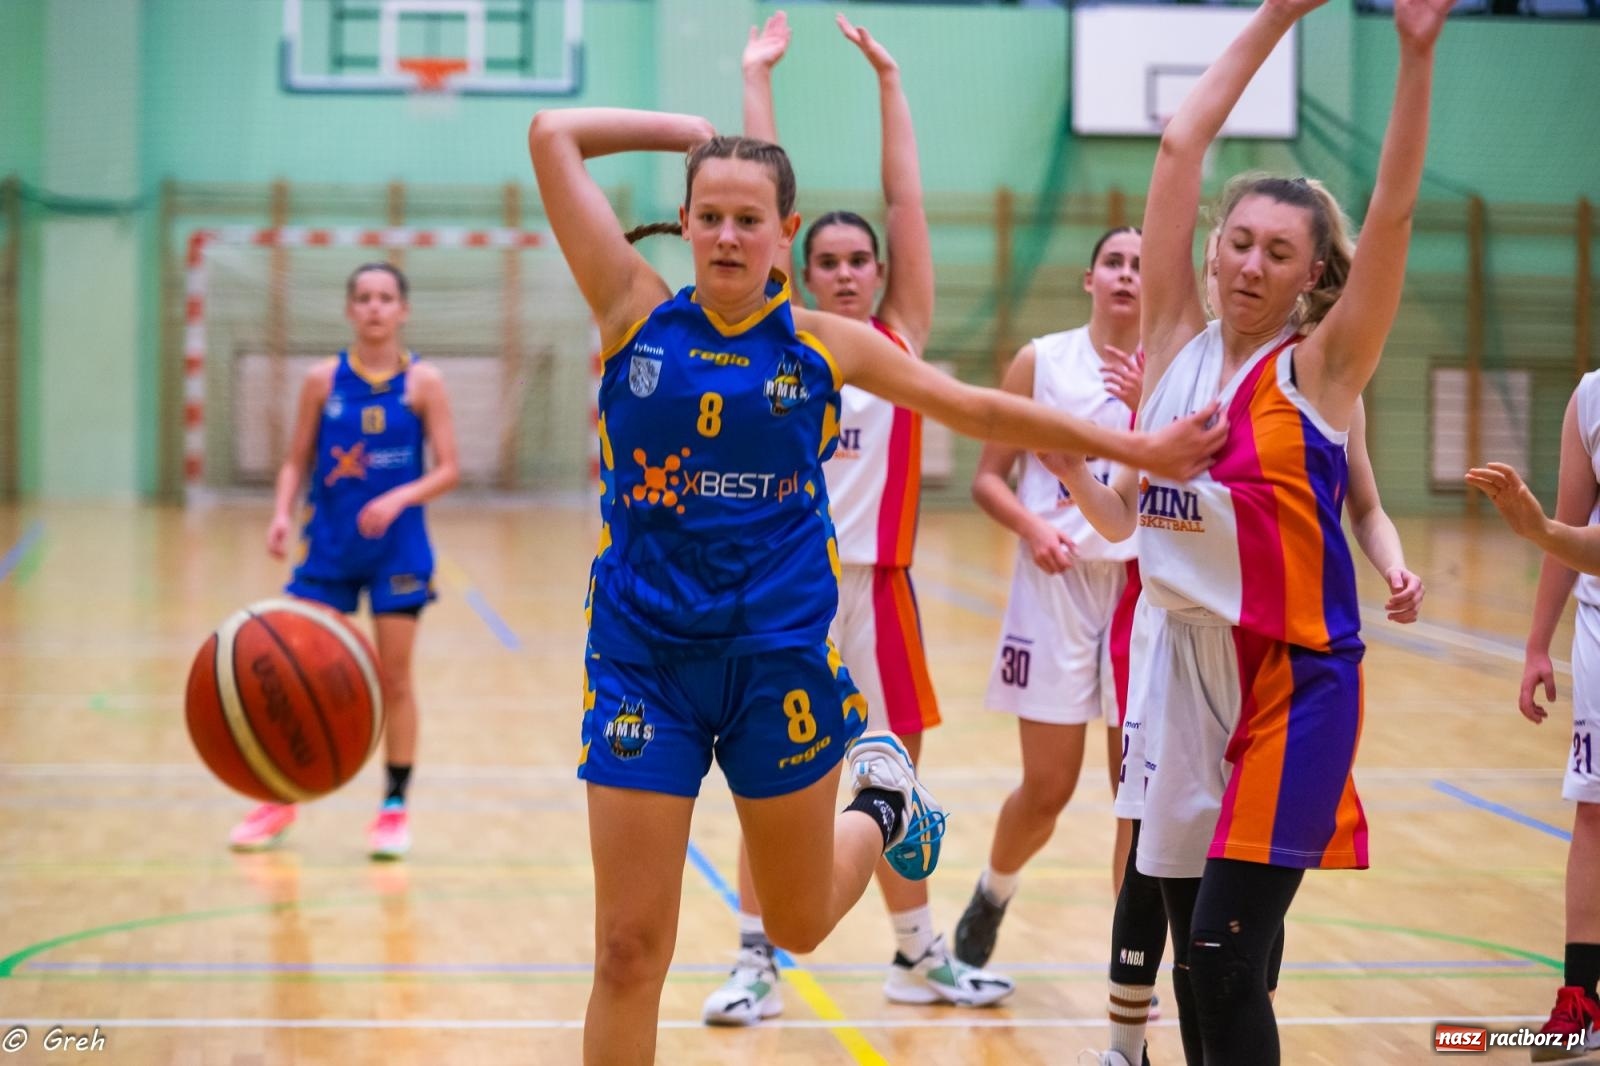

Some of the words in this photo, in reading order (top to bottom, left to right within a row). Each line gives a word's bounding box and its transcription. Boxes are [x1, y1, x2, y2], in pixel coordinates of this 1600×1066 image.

[689, 348, 750, 367] regio
[765, 379, 808, 401] RMKS
[697, 392, 723, 438] 8
[682, 470, 798, 503] XBEST.pl
[1139, 515, 1205, 533] SKETBALL
[1002, 646, 1031, 689] 30
[604, 720, 653, 741] RMKS
[783, 689, 817, 743] 8
[778, 735, 832, 769] regio
[1573, 732, 1592, 774] 21
[1126, 950, 1145, 967] NBA
